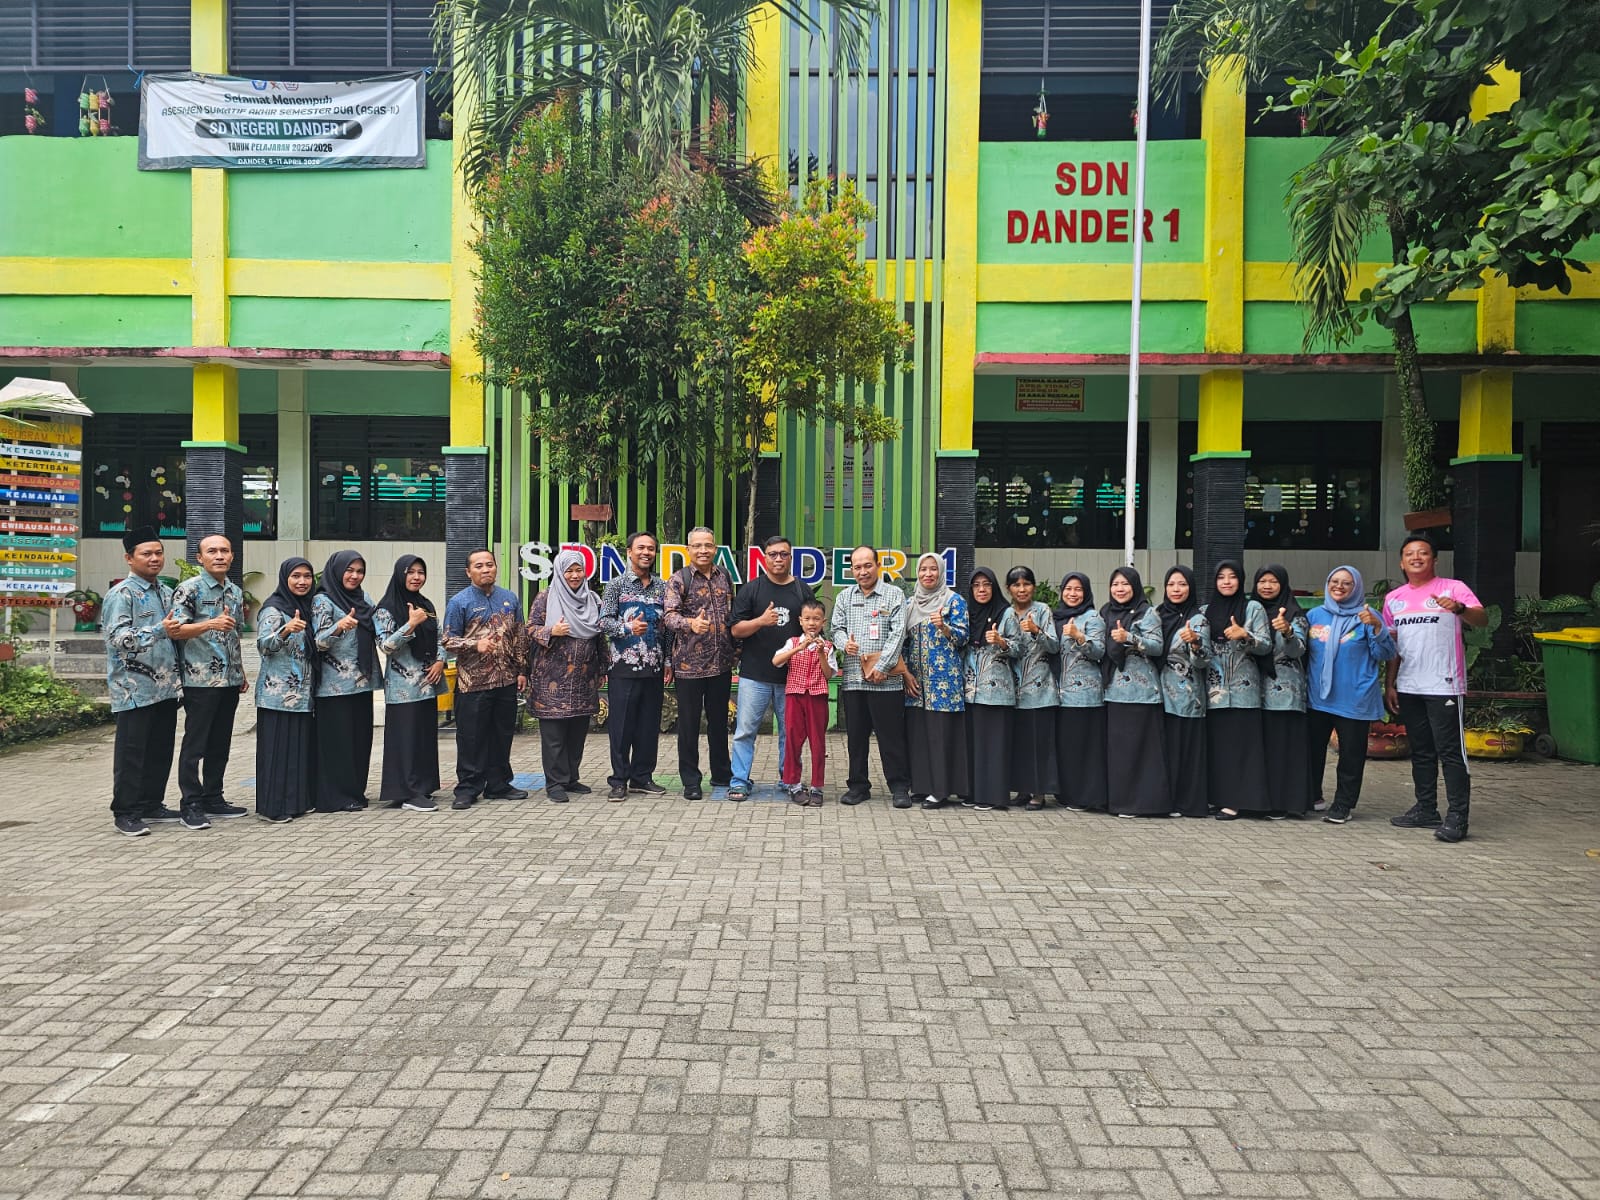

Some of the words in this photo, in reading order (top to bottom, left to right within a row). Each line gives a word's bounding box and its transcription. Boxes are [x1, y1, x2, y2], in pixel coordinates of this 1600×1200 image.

[224, 93, 270, 105] Selamat
[272, 94, 333, 106] Menempuh
[161, 104, 202, 117] ASESMEN
[204, 105, 247, 115] SUMATIF
[248, 108, 278, 116] AKHIR
[279, 107, 335, 116] SEMESTER
[333, 106, 354, 115] DUA
[209, 121, 227, 134] SD
[230, 122, 279, 136] NEGERI
[283, 122, 338, 136] DANDER
[228, 142, 249, 152] TAHUN
[251, 142, 290, 152] PELAJARAN
[291, 143, 333, 153] 2025/2026
[1055, 161, 1129, 196] SDN
[1007, 208, 1154, 244] DANDER
[1163, 208, 1180, 243] 1
[6, 446, 70, 458] KETAQWAAN
[6, 461, 69, 472] KETERTIBAN
[6, 491, 66, 502] KEAMANAN
[0, 507, 74, 516] ETERBUKAAN
[1, 521, 75, 532] EWIRAUSAHAAN
[4, 553, 63, 561] KEINDAHAN
[1, 567, 64, 576] KEBERSIHAN
[6, 583, 58, 591] KERAPIAN
[0, 598, 70, 606] ETELADANAN
[1394, 615, 1440, 628] DANDER
